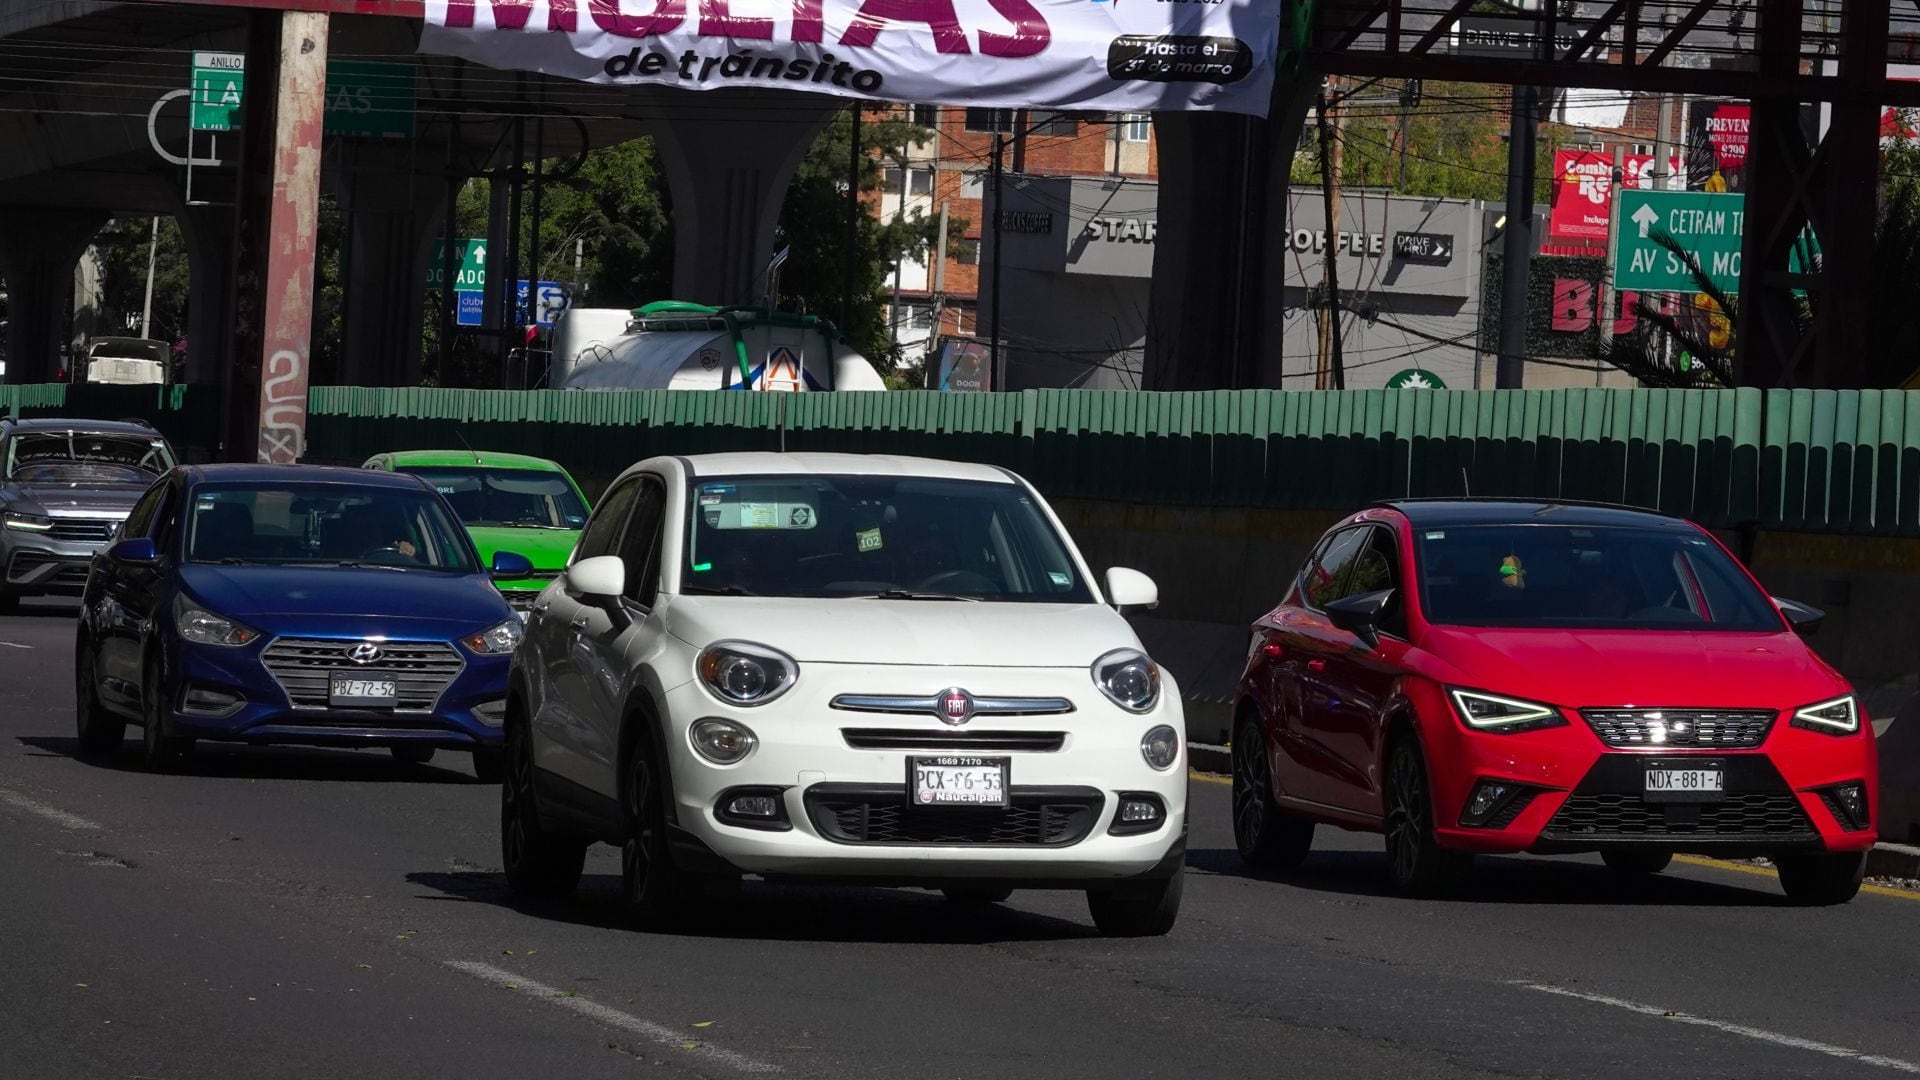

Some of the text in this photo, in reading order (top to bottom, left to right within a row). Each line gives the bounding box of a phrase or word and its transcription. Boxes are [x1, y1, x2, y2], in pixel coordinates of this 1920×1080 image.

[1145, 42, 1218, 56] Hasta el
[210, 56, 241, 68] ANILLO
[604, 47, 883, 92] de tránsito
[1149, 60, 1171, 72] de
[1174, 62, 1233, 75] marzo
[325, 86, 372, 114] AS
[1565, 160, 1624, 176] Comb
[1579, 174, 1613, 204] Re
[1669, 208, 1744, 236] CETRAM T
[1397, 235, 1430, 247] DRIVE
[1399, 244, 1428, 256] THRU
[1629, 248, 1657, 273] AV
[426, 269, 485, 285] DOADO
[860, 536, 881, 549] 102
[332, 680, 395, 696] PBZ-72-52
[947, 699, 965, 713] FIAT
[960, 758, 982, 766] 7170
[1648, 771, 1722, 789] NDX-881-A
[936, 791, 1002, 803] Naucalpan
